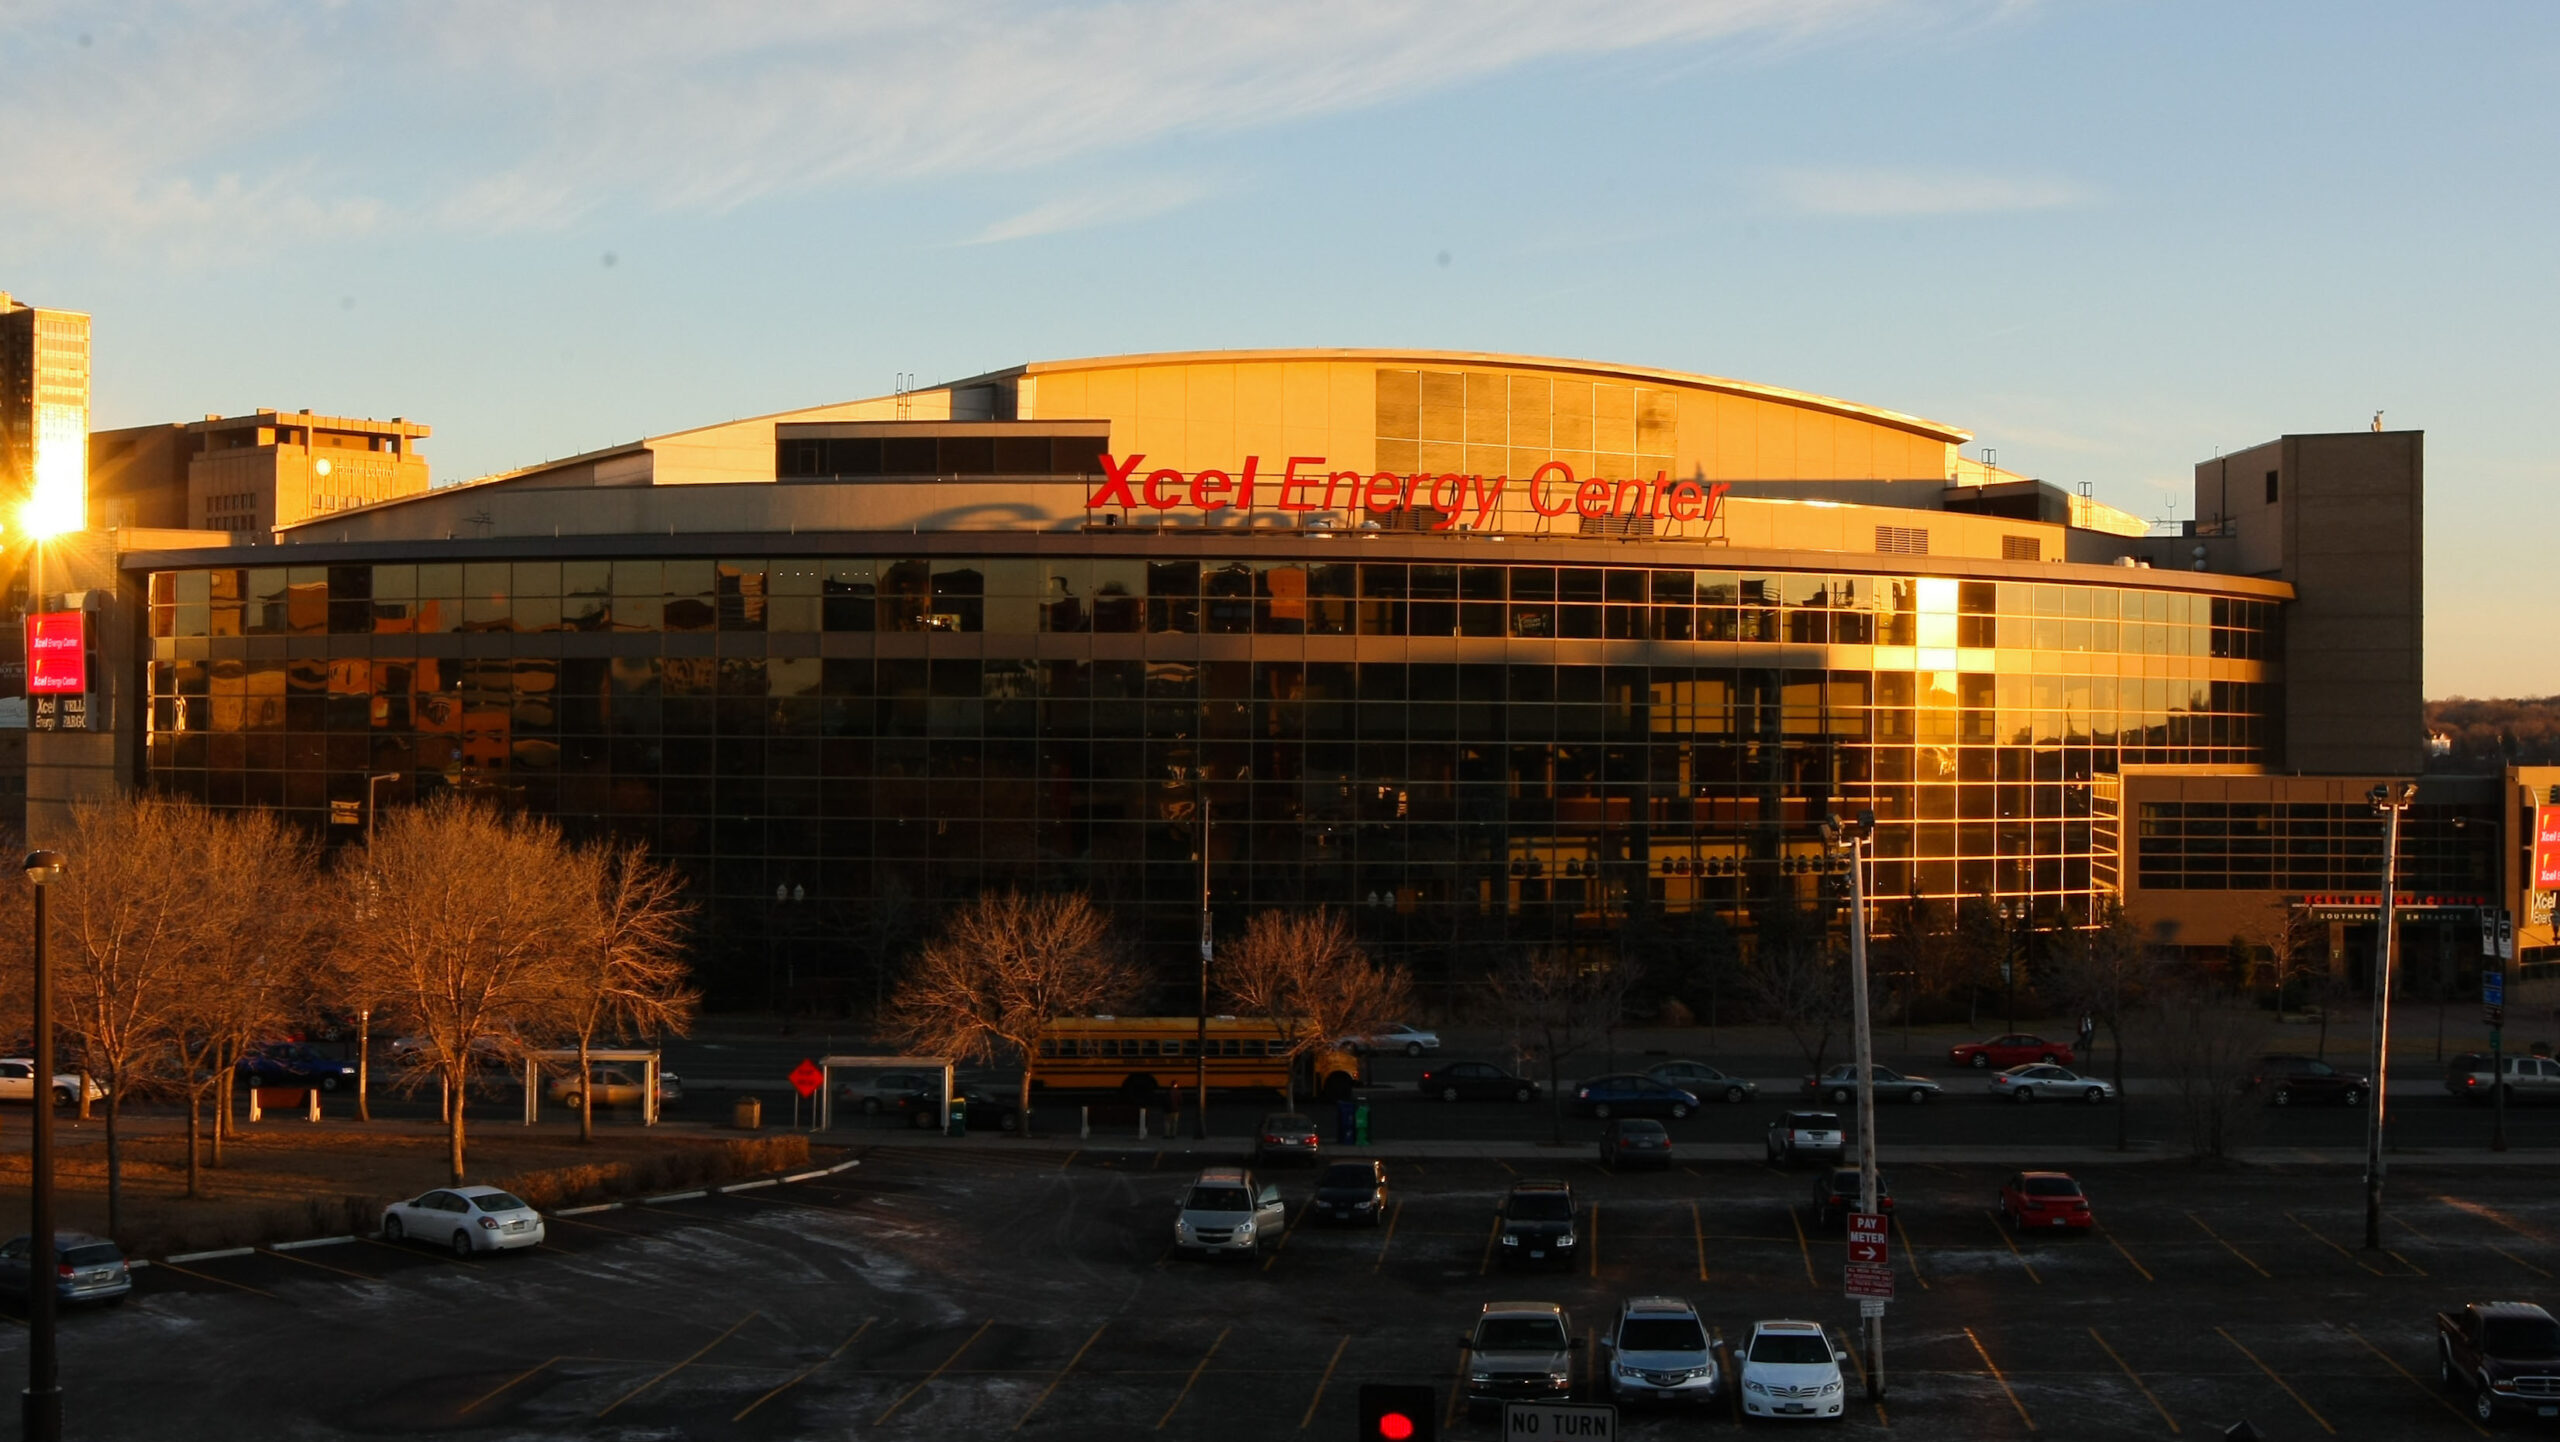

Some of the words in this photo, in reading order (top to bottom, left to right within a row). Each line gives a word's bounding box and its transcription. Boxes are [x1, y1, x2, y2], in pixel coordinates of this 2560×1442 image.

[1084, 454, 1259, 511] Xcel
[1278, 457, 1507, 530] Energy
[1529, 460, 1731, 521] Center
[34, 637, 48, 648] Xcel
[48, 638, 62, 650] Energy
[33, 676, 47, 686] Xcel
[47, 677, 62, 688] Energy
[36, 698, 56, 714] Xcel
[2540, 831, 2556, 842] Xcel
[2541, 870, 2557, 881] Xcel
[2304, 894, 2342, 905] XCEL
[2354, 894, 2413, 905] ENEGY
[2535, 892, 2557, 909] Xcel
[1857, 1217, 1877, 1229] PAY
[1850, 1231, 1885, 1244] METER
[1512, 1412, 1539, 1434] NO
[1552, 1414, 1607, 1436] TURN
